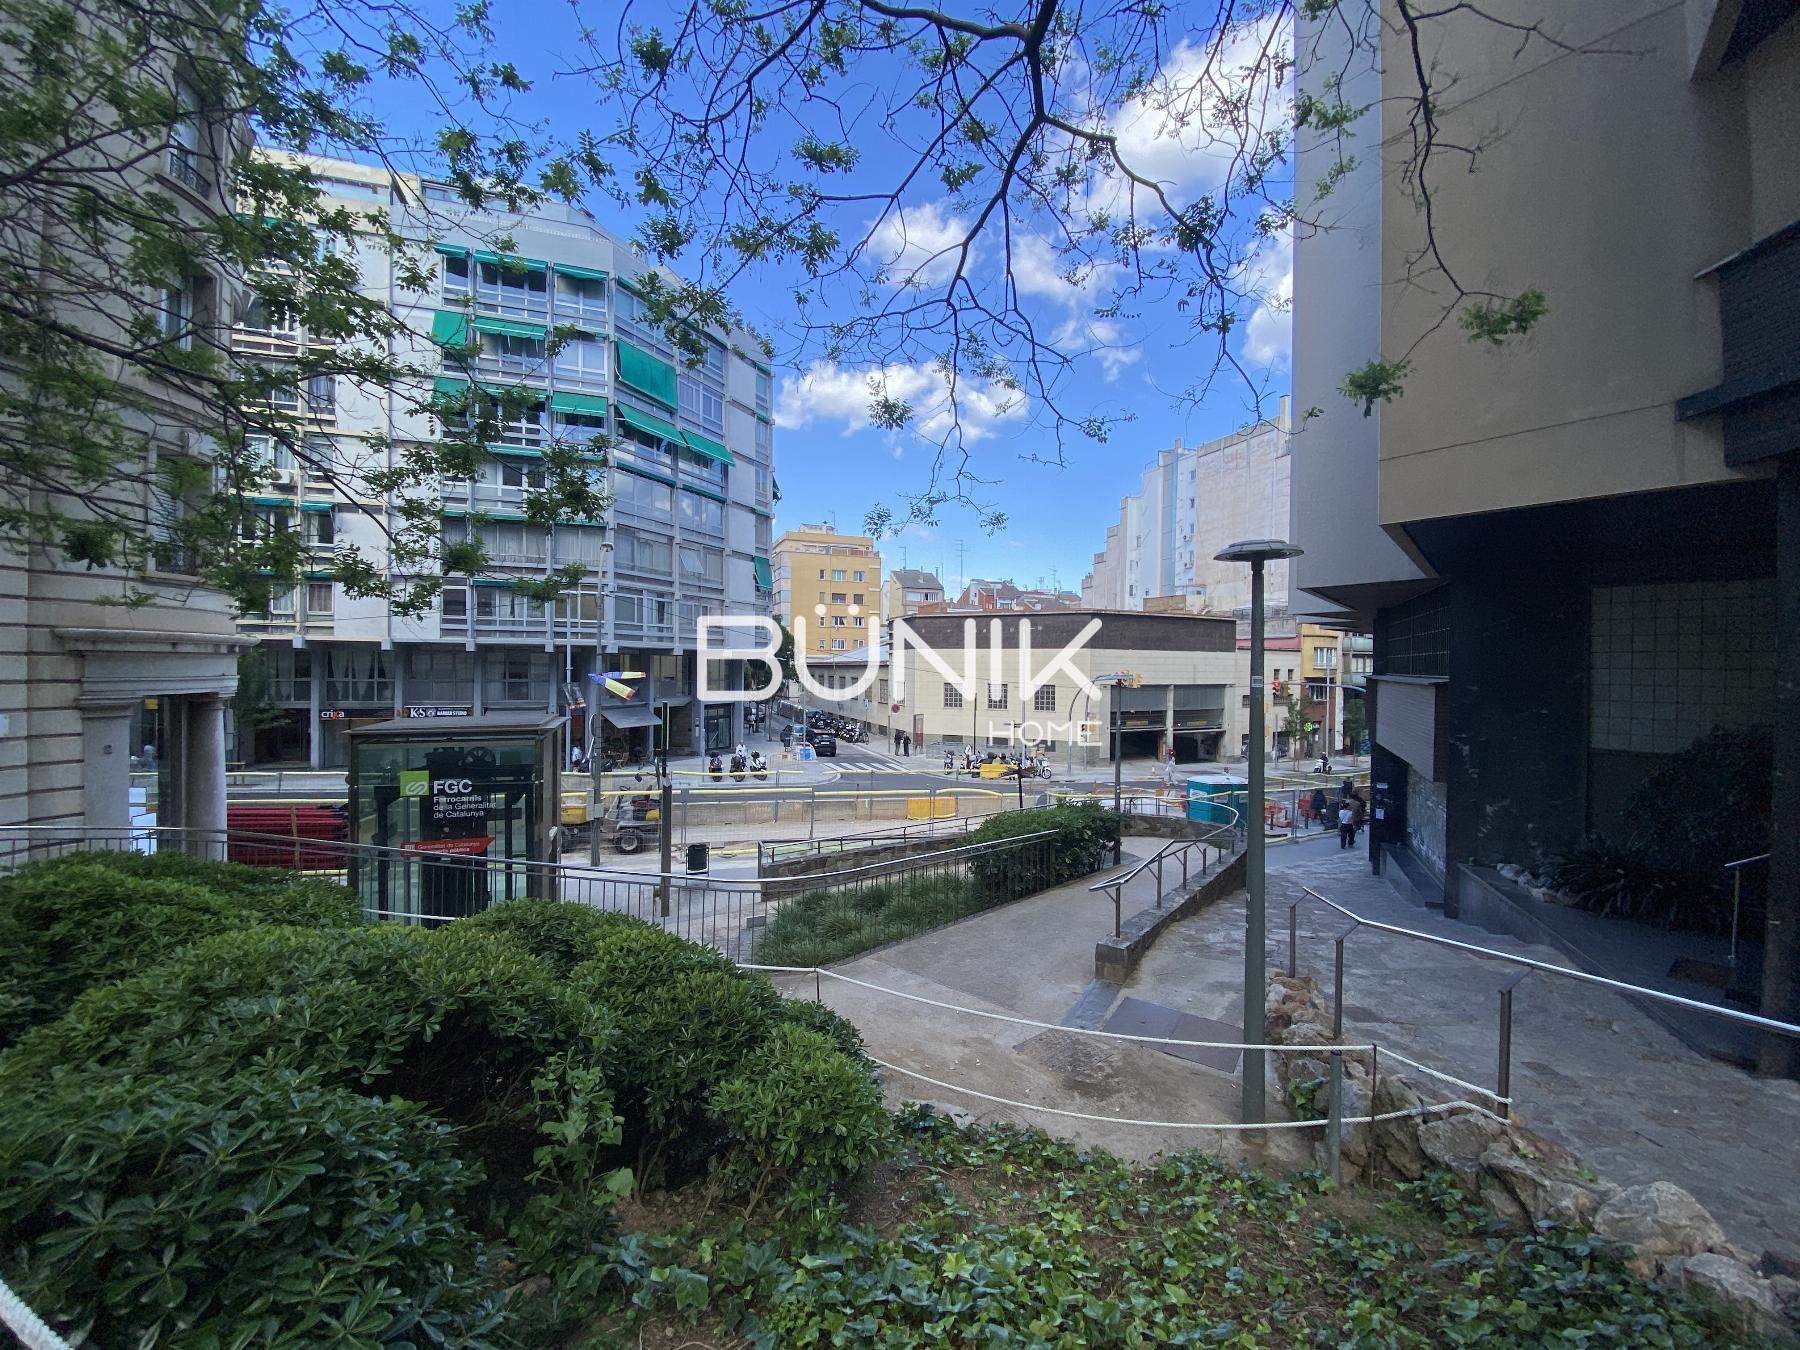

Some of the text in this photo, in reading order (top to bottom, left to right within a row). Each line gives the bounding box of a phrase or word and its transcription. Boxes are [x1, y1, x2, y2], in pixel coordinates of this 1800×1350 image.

[433, 779, 473, 794] FGC
[433, 810, 484, 819] de Catalunya
